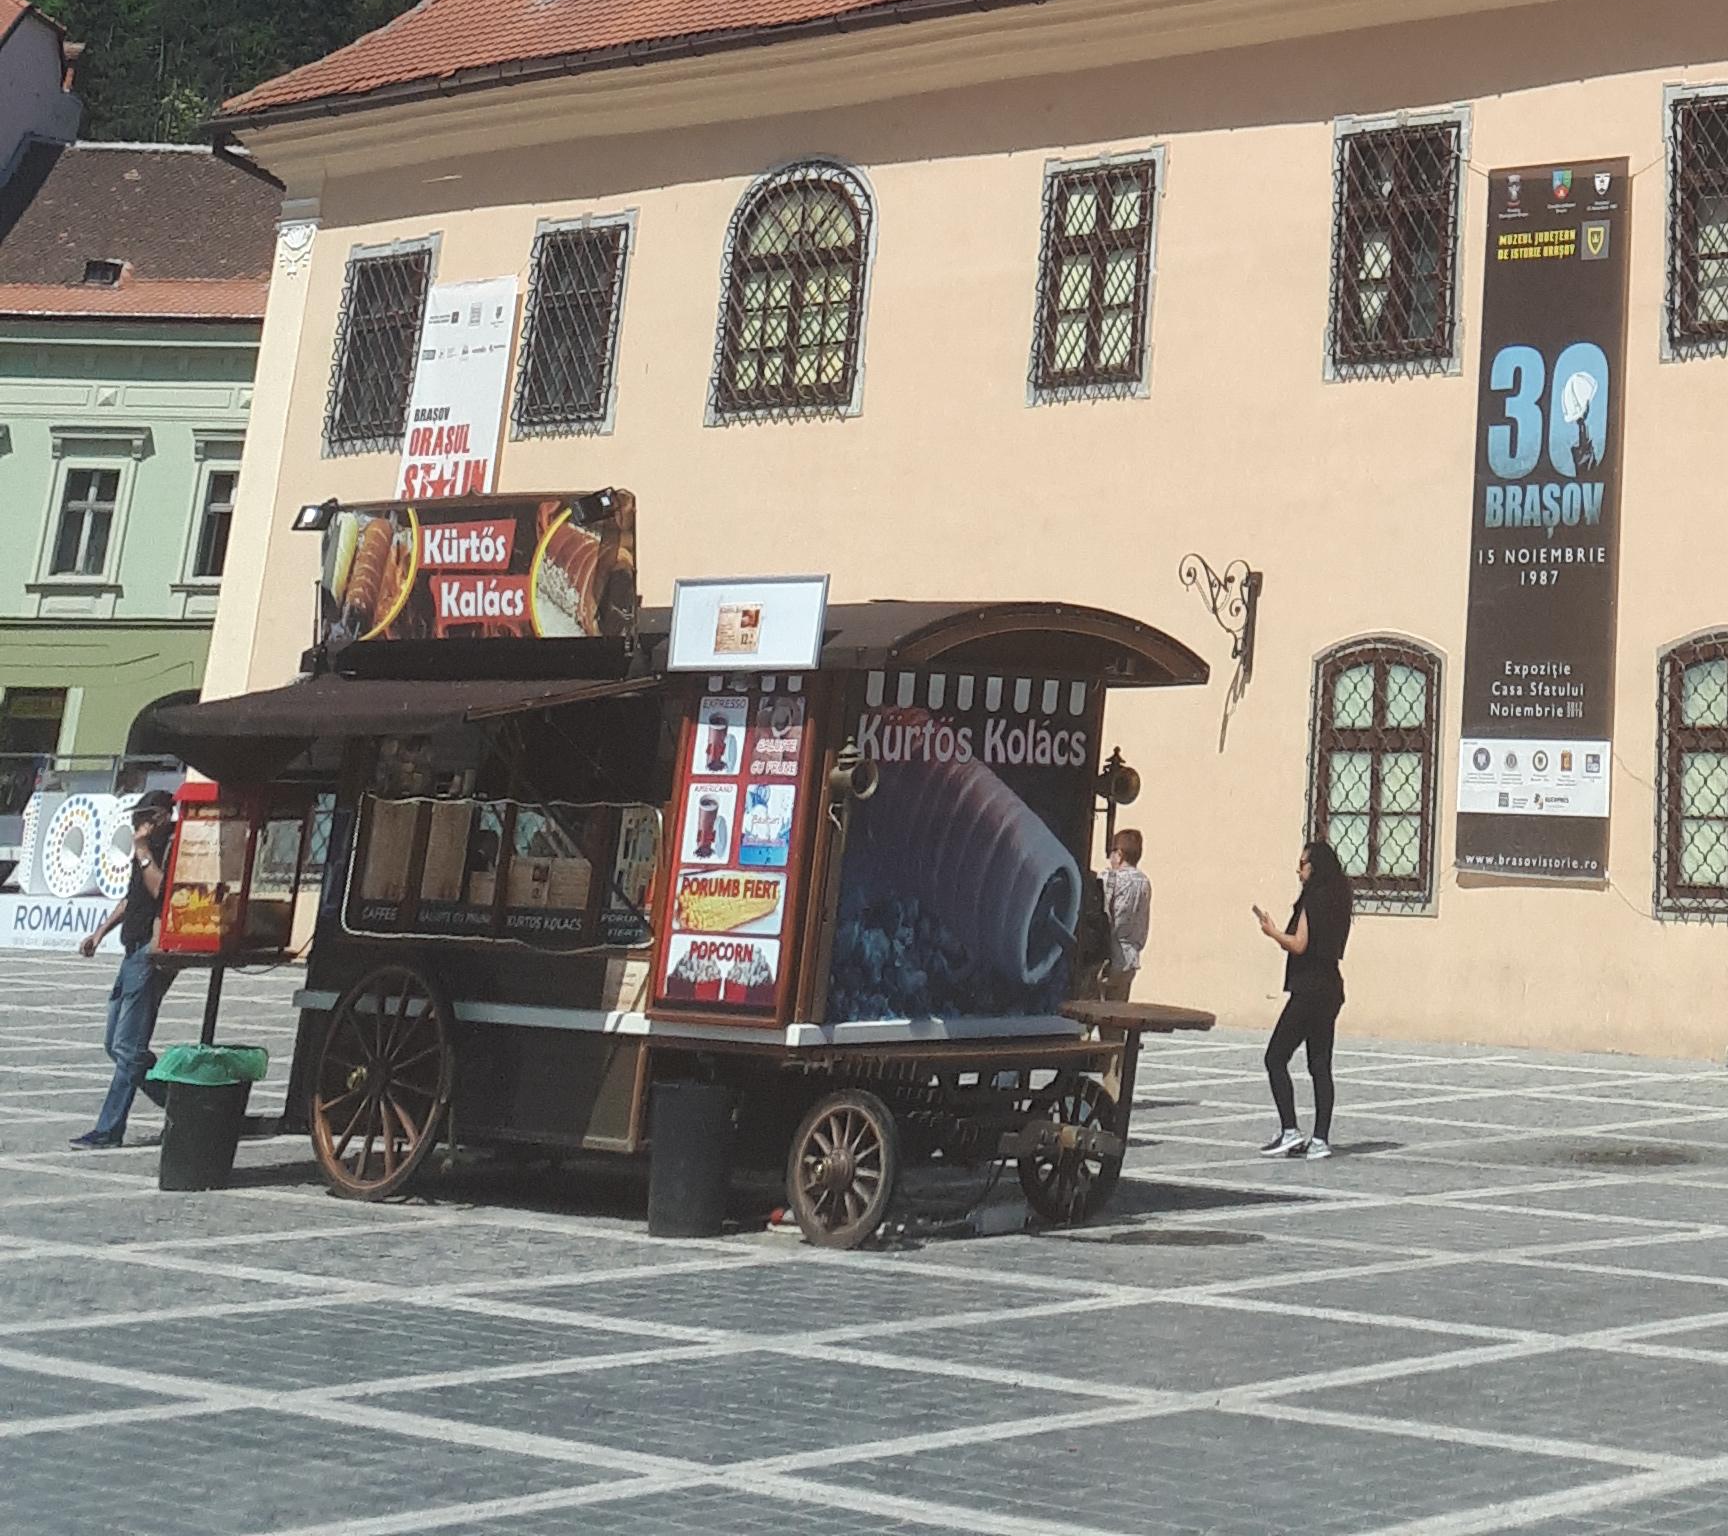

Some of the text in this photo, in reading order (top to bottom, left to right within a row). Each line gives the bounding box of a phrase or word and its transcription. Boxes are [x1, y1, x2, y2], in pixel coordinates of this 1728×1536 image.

[1498, 233, 1533, 246] MUZEUL
[1497, 249, 1509, 260] DE
[1510, 247, 1541, 259] ISTORIE
[1488, 343, 1609, 480] 30
[1485, 482, 1605, 539] BRAȘOV
[423, 526, 507, 565] Kürtős
[1478, 547, 1607, 564] 15 NOIEMBRIE
[1520, 570, 1560, 586] 1987
[440, 578, 525, 618] Kalács
[1491, 681, 1584, 697] Casa Sfatului
[1490, 702, 1564, 718] Noiembrie
[857, 713, 1088, 767] Kürtös Kolács
[1465, 853, 1598, 870] www.brasovistorie.ro
[681, 876, 780, 900] PORUMB FIERT
[689, 940, 754, 963] POPCORN
